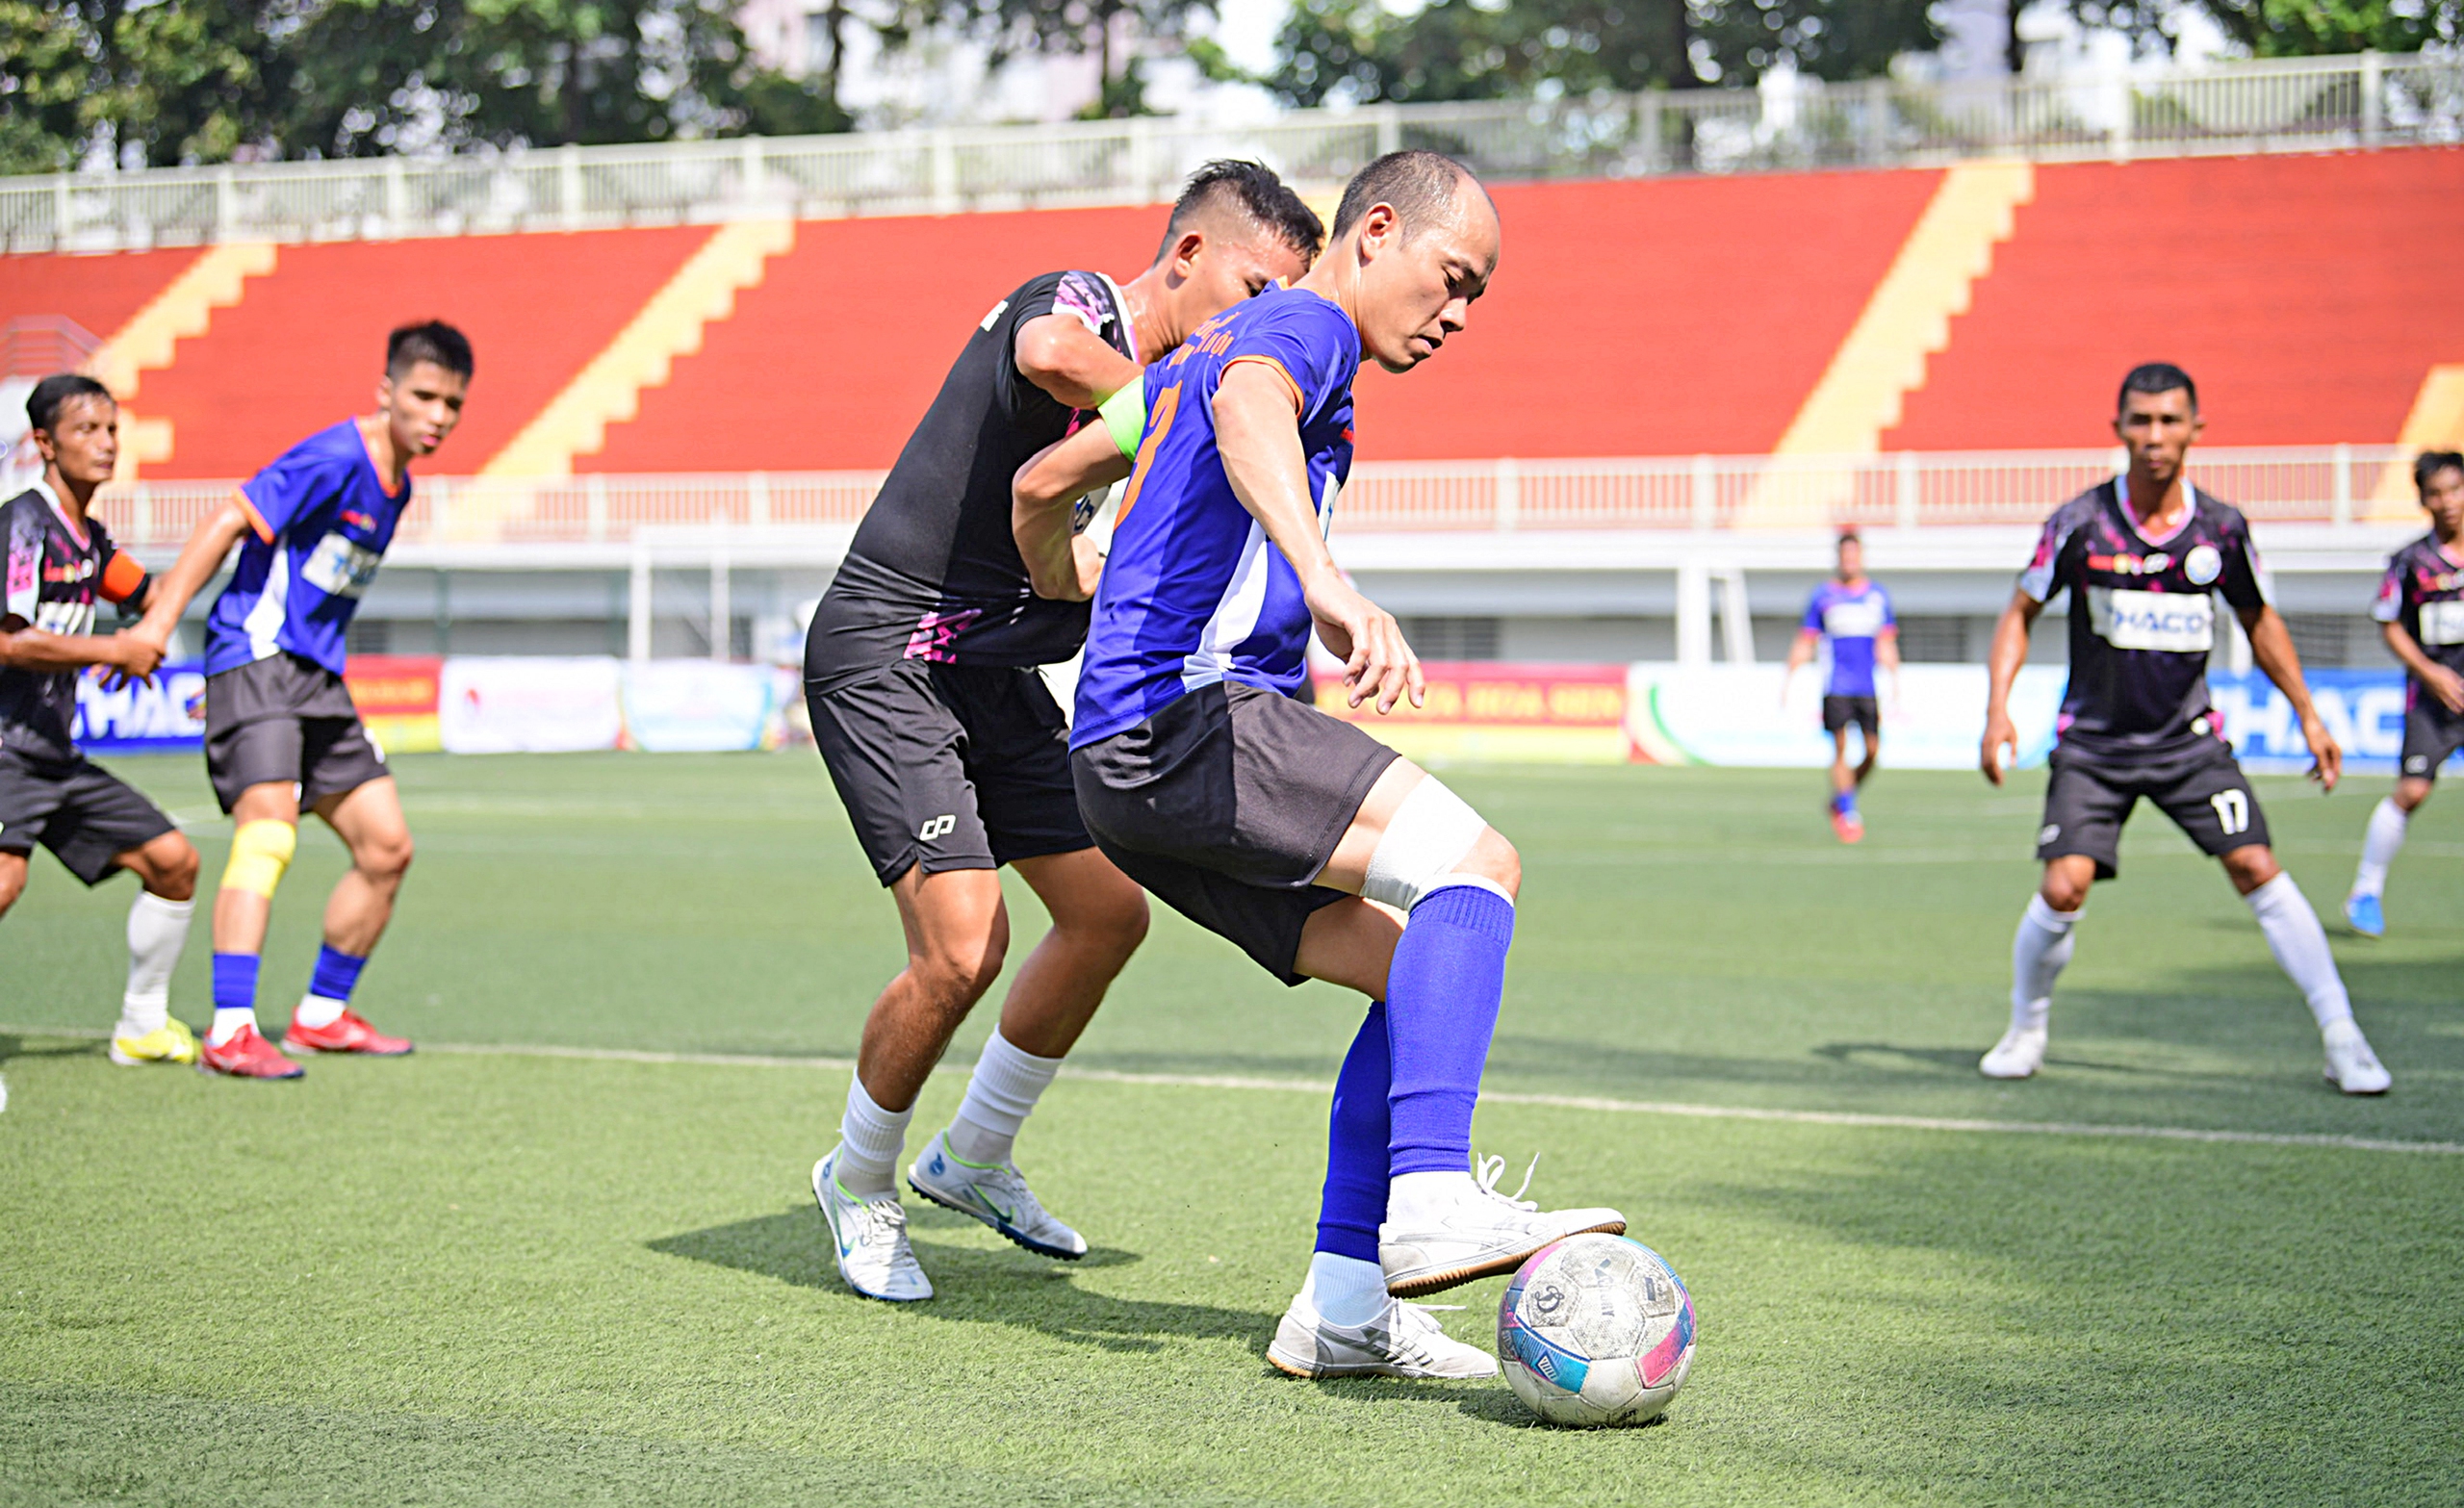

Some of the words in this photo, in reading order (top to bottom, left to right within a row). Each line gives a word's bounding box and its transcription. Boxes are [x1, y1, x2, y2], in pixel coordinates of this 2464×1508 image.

[70, 673, 207, 740] HAC
[2211, 686, 2406, 757] HAC
[2211, 789, 2248, 834] 17
